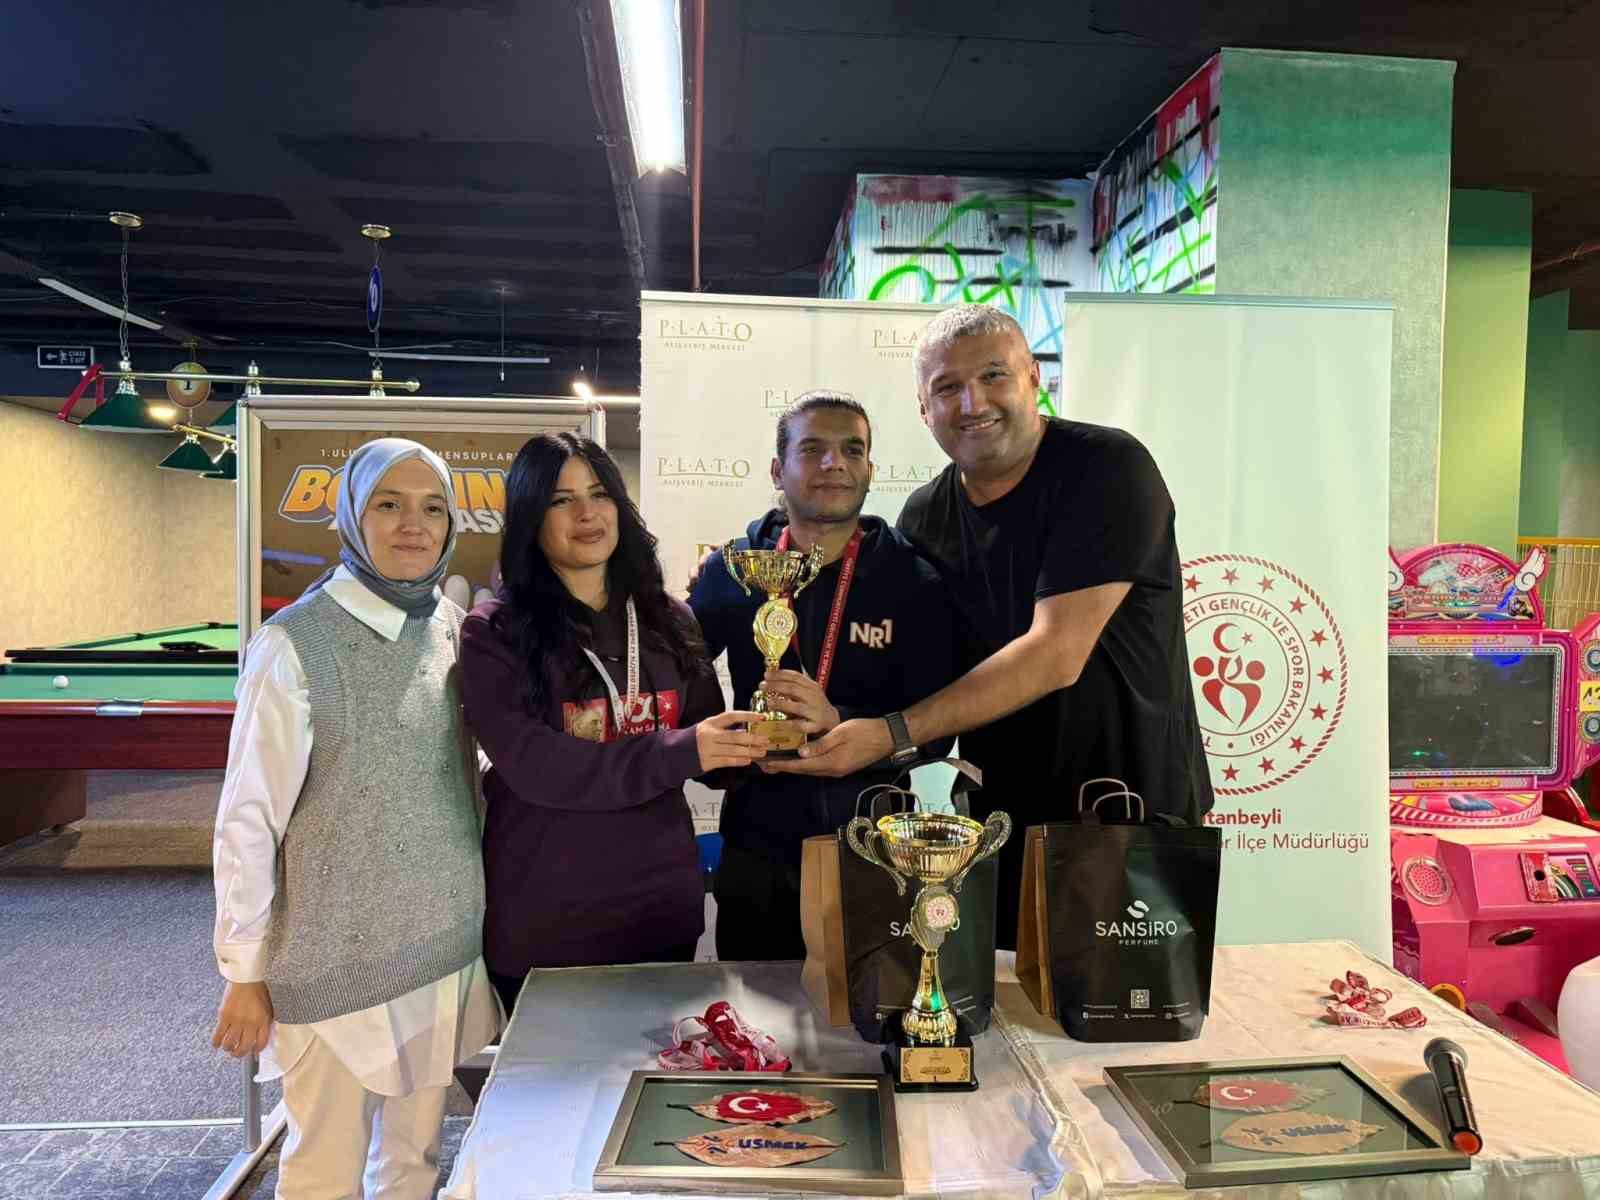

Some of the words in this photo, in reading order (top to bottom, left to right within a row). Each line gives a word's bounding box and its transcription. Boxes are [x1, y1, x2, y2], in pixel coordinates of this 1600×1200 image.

[434, 451, 518, 460] ENSUPLAR
[1183, 602, 1206, 625] ETİ
[1208, 598, 1271, 622] GENÇLİK
[850, 618, 893, 649] NR1
[1271, 616, 1290, 637] VE
[1283, 635, 1305, 677] SPOR
[1250, 680, 1305, 747] BAKANLIĞI
[1236, 830, 1267, 853] İlçe
[1272, 832, 1370, 853] Müdürlüğü
